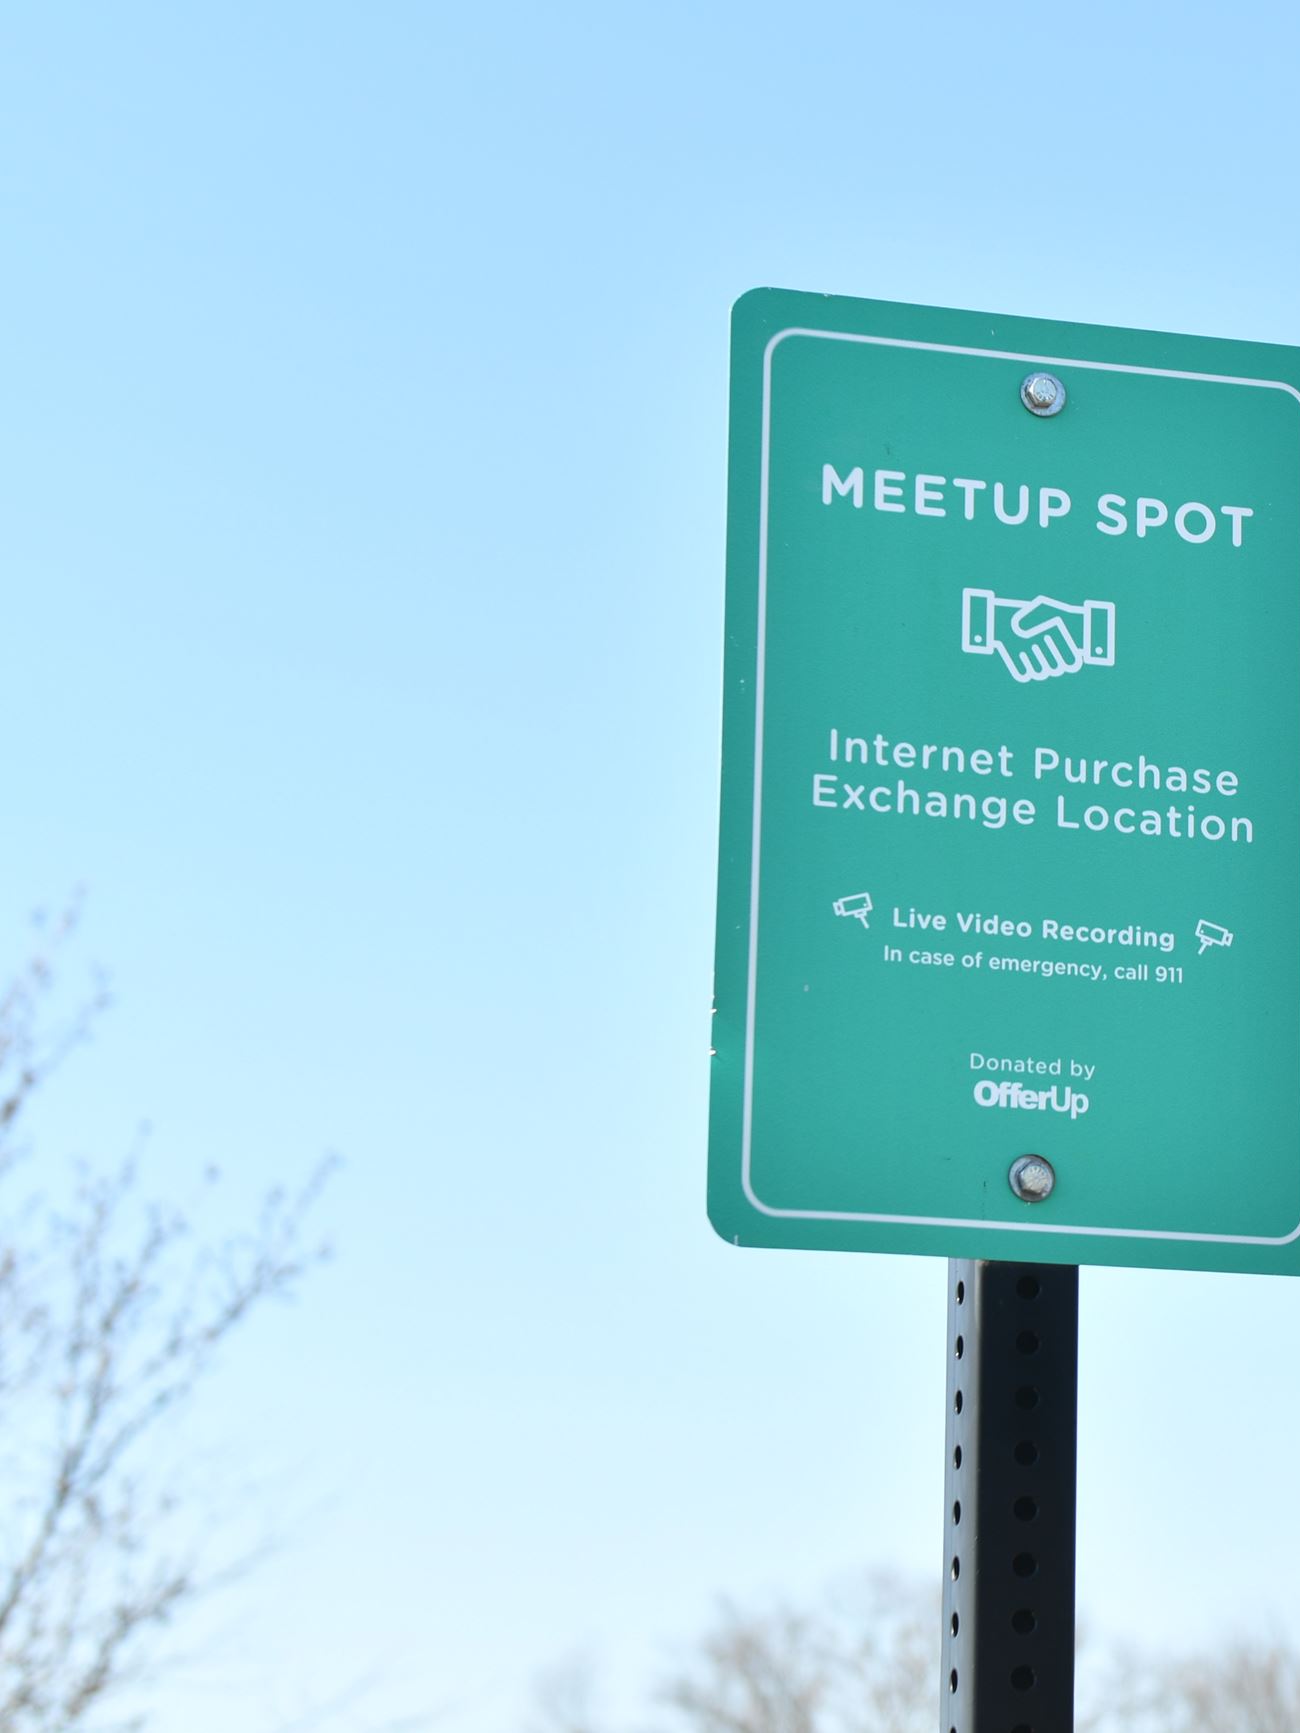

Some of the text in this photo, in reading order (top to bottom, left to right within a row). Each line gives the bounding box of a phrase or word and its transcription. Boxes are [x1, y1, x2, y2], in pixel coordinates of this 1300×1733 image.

[822, 463, 1254, 548] MEETUP SPOT
[830, 728, 1239, 796] Internet Purchase
[812, 773, 1254, 843] Exchange Location
[893, 907, 1175, 953] Live Video Recording
[884, 945, 1184, 984] In case of emergency, call 911
[970, 1053, 1096, 1081] Donated by
[973, 1079, 1089, 1120] OfferUp
